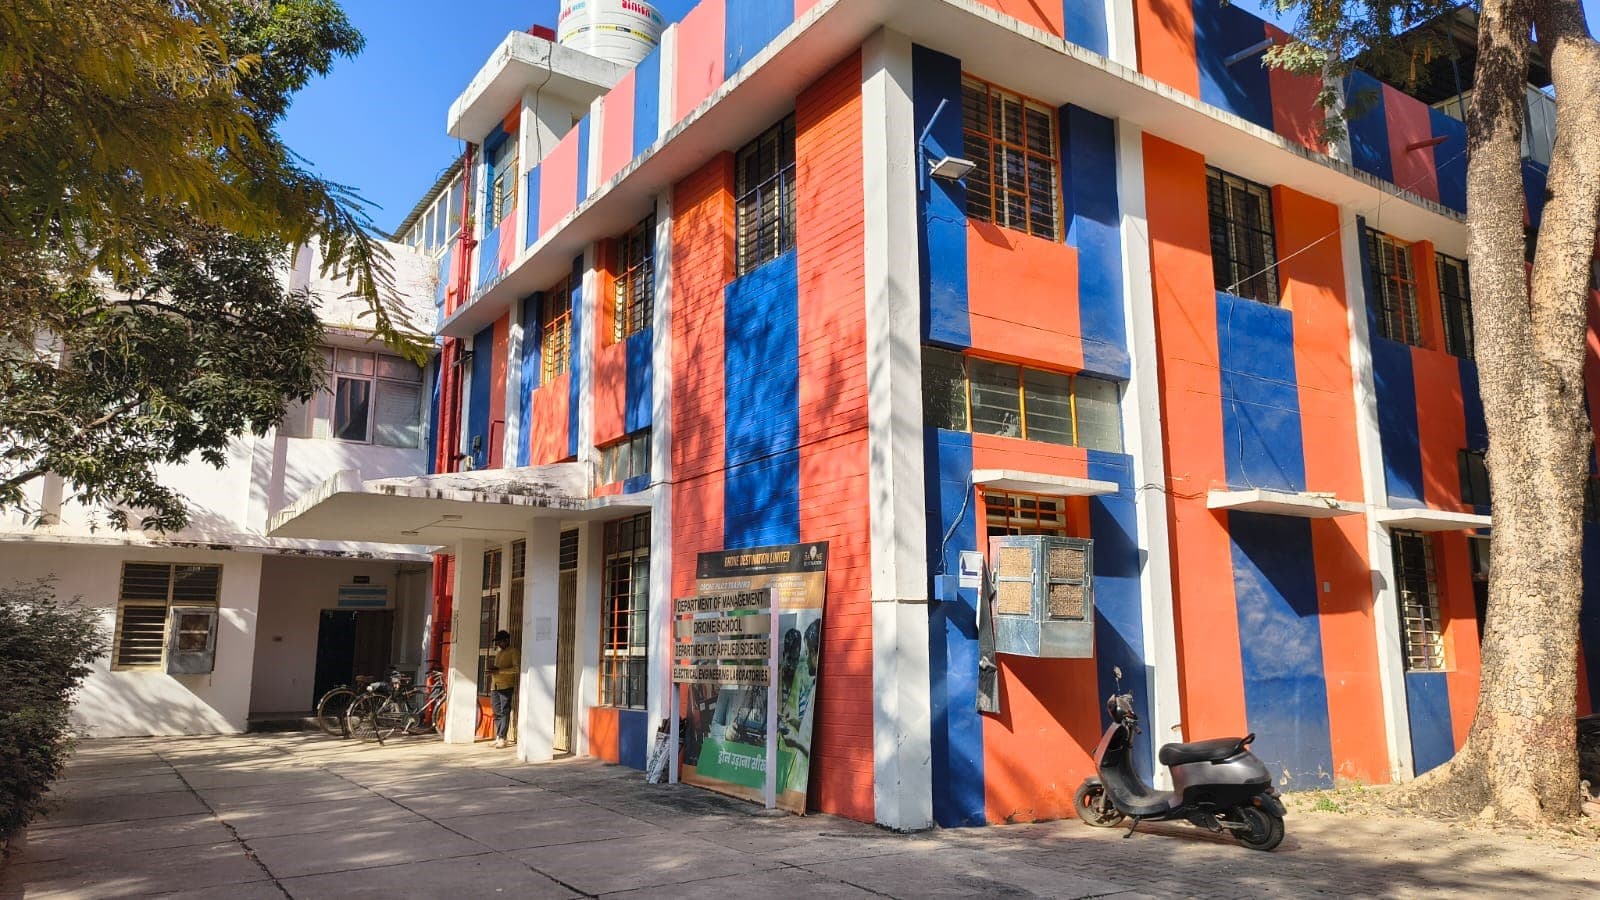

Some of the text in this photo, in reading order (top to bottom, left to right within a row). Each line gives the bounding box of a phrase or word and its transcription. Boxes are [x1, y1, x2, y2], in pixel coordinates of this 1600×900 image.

[677, 598, 712, 612] DEPARTMENT
[713, 597, 721, 609] OF
[722, 592, 764, 608] MANAGEMENT
[693, 619, 743, 634] DRONE SCHOOL
[675, 641, 767, 657] DEPARTMENT OF APPLIED SCIENCE
[673, 668, 768, 682] ELECTRICAL ENGINEERING LABORATORIES
